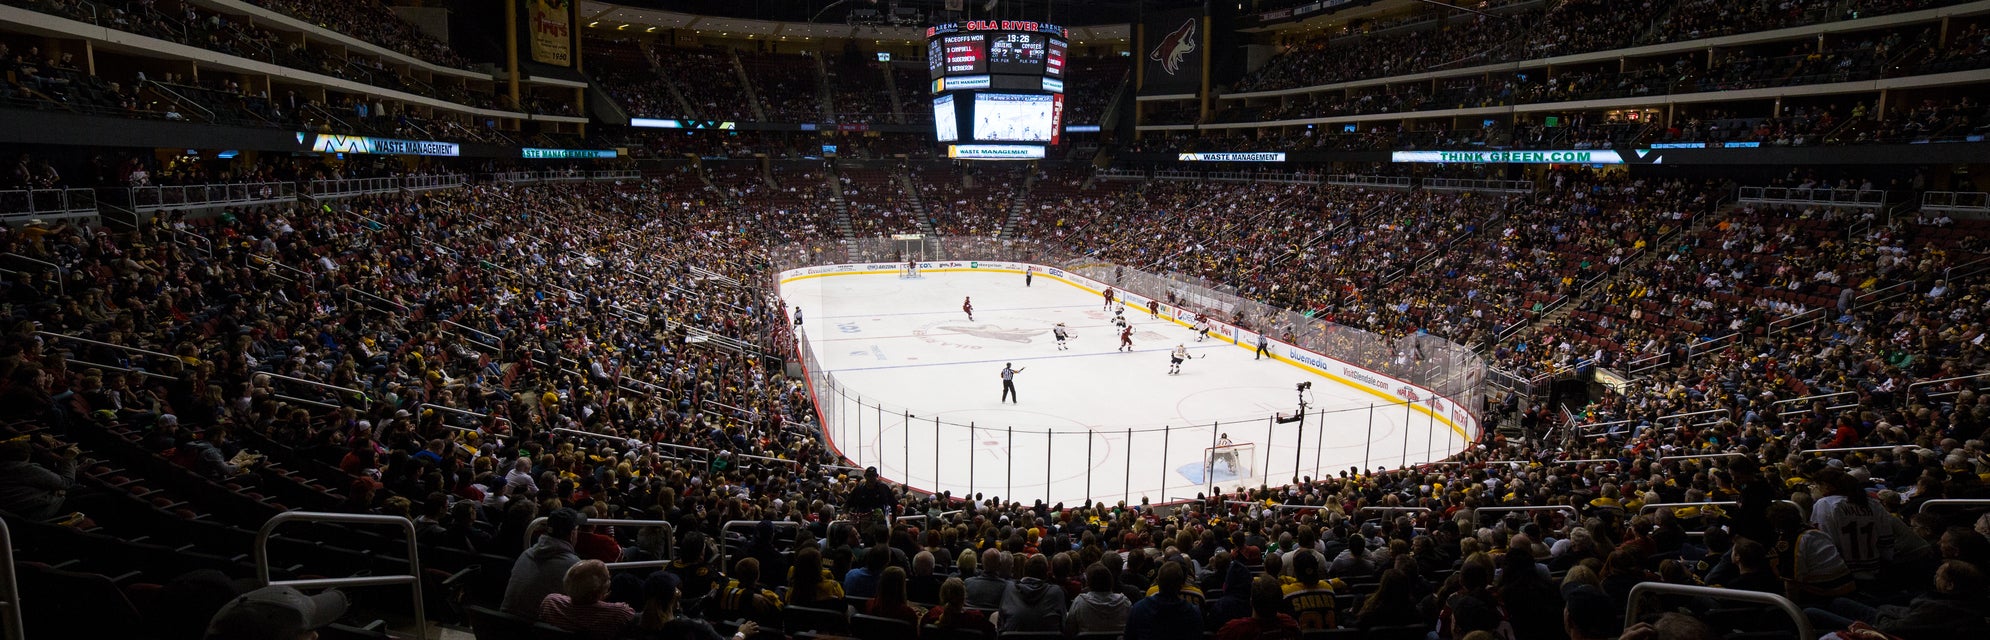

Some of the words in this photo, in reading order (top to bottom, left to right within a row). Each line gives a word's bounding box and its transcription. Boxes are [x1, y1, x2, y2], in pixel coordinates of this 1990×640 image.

[967, 20, 998, 30] GILA
[1001, 20, 1039, 32] RIVER
[374, 140, 403, 152] WASTE
[405, 142, 453, 154] MANAGEMENT
[1203, 153, 1230, 161] WASTE
[1231, 153, 1278, 161] MANAGEMENT
[1440, 151, 1483, 162] THINK
[1490, 151, 1591, 162] GREEN.COM
[1049, 267, 1064, 278] GEICO
[1289, 348, 1327, 370] bluemedia
[1343, 367, 1389, 390] VisitGlendale.com
[1841, 503, 1874, 517] WALSH
[1292, 594, 1335, 612] SAVARD
